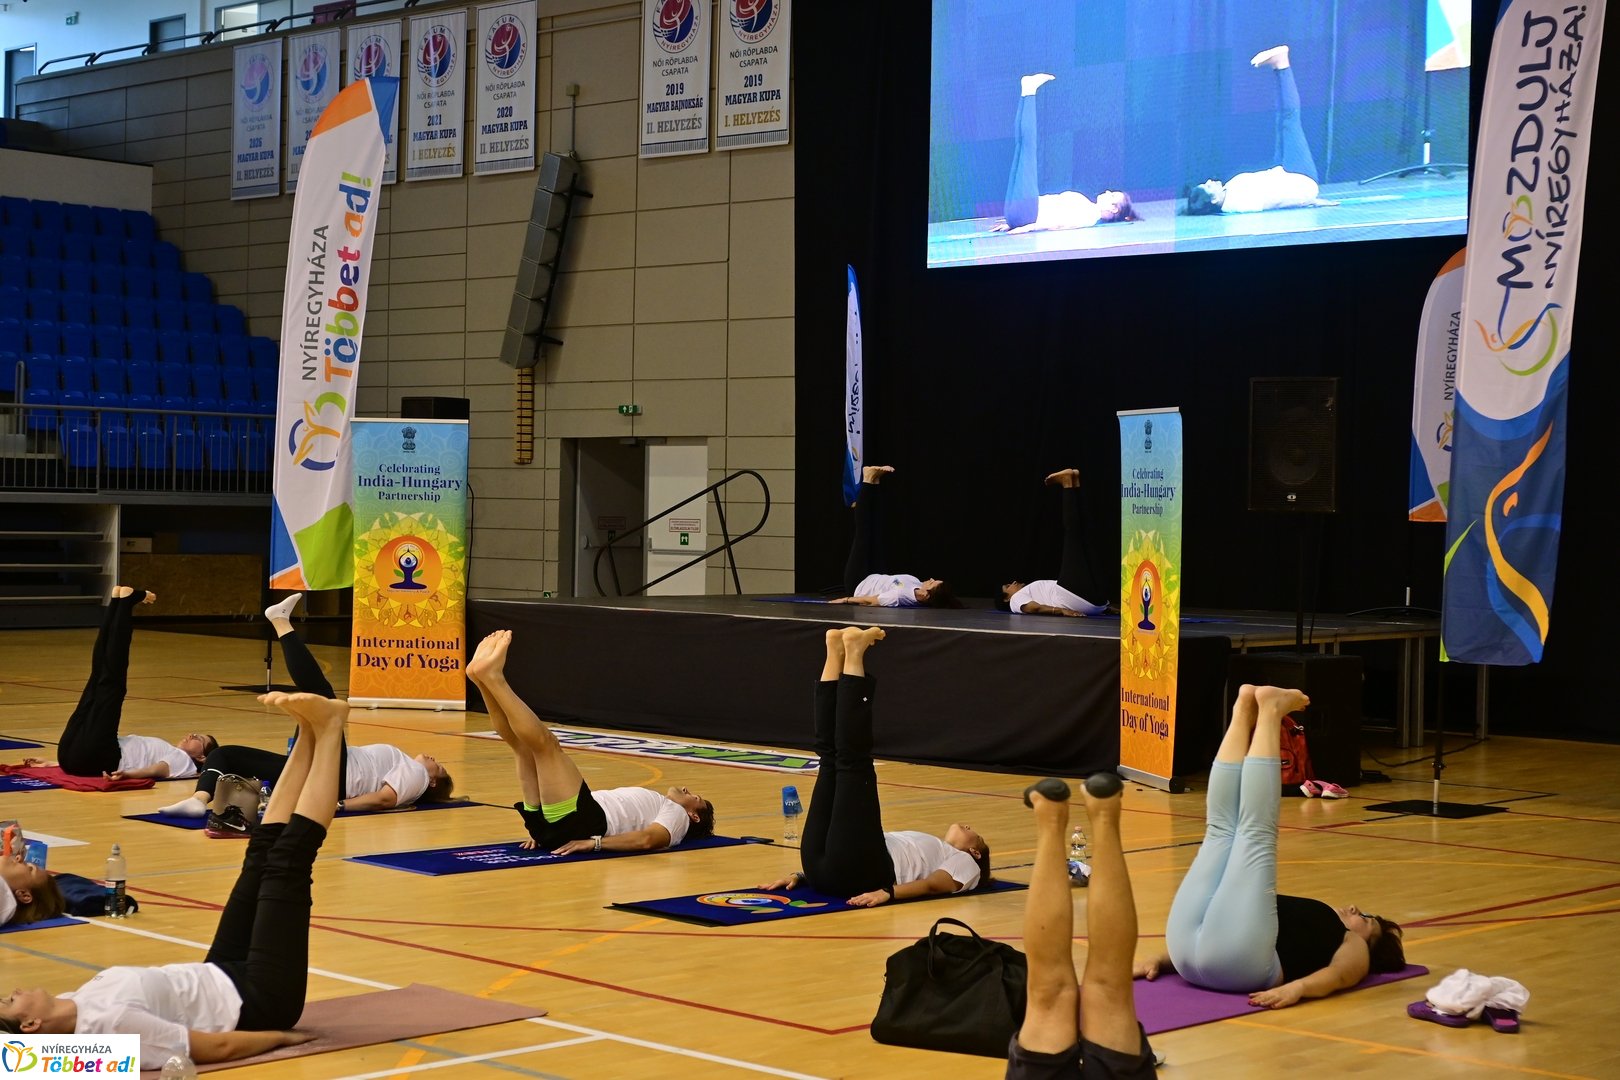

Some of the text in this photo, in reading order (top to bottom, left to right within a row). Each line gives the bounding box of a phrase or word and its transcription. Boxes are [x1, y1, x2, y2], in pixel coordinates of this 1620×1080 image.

[739, 57, 768, 68] CSAPATA
[661, 68, 689, 77] CSAPATA
[744, 73, 763, 88] 2019
[493, 91, 517, 101] CSAPATA
[665, 82, 685, 96] 2019
[646, 94, 703, 114] MAGYAR BAJNOKSÁG
[725, 89, 782, 106] MAGYAR KUPA
[427, 114, 442, 127] 2021
[496, 106, 513, 119] 2020
[724, 106, 781, 128] I. HELYEZÉS
[481, 119, 528, 136] MAGYAR KUPA
[646, 113, 703, 135] II. HELYEZÉS
[413, 128, 457, 142] MAGYAR KUPA
[418, 143, 456, 160] HELYEZÉS
[480, 136, 530, 155] II. HELYEZÉS
[1535, 5, 1587, 289] NYÍREGYHÁZA!
[237, 150, 274, 164] MAGYAR KUPA
[323, 171, 373, 383] Többet ad!
[301, 224, 329, 382] NYÍREGYHÁZA
[1443, 310, 1462, 401] NYÍREGYHÁZA
[378, 463, 441, 476] Celebrating
[1132, 467, 1164, 481] Celebrating
[358, 475, 463, 491] India-Hungary
[378, 491, 441, 503] Partnership
[1120, 482, 1176, 501] India-Hungary
[1132, 503, 1164, 517] Partnership
[356, 635, 460, 650] International
[356, 652, 460, 672] Day of Yoga
[1121, 687, 1169, 712] International
[1121, 708, 1169, 740] Day of Yoga
